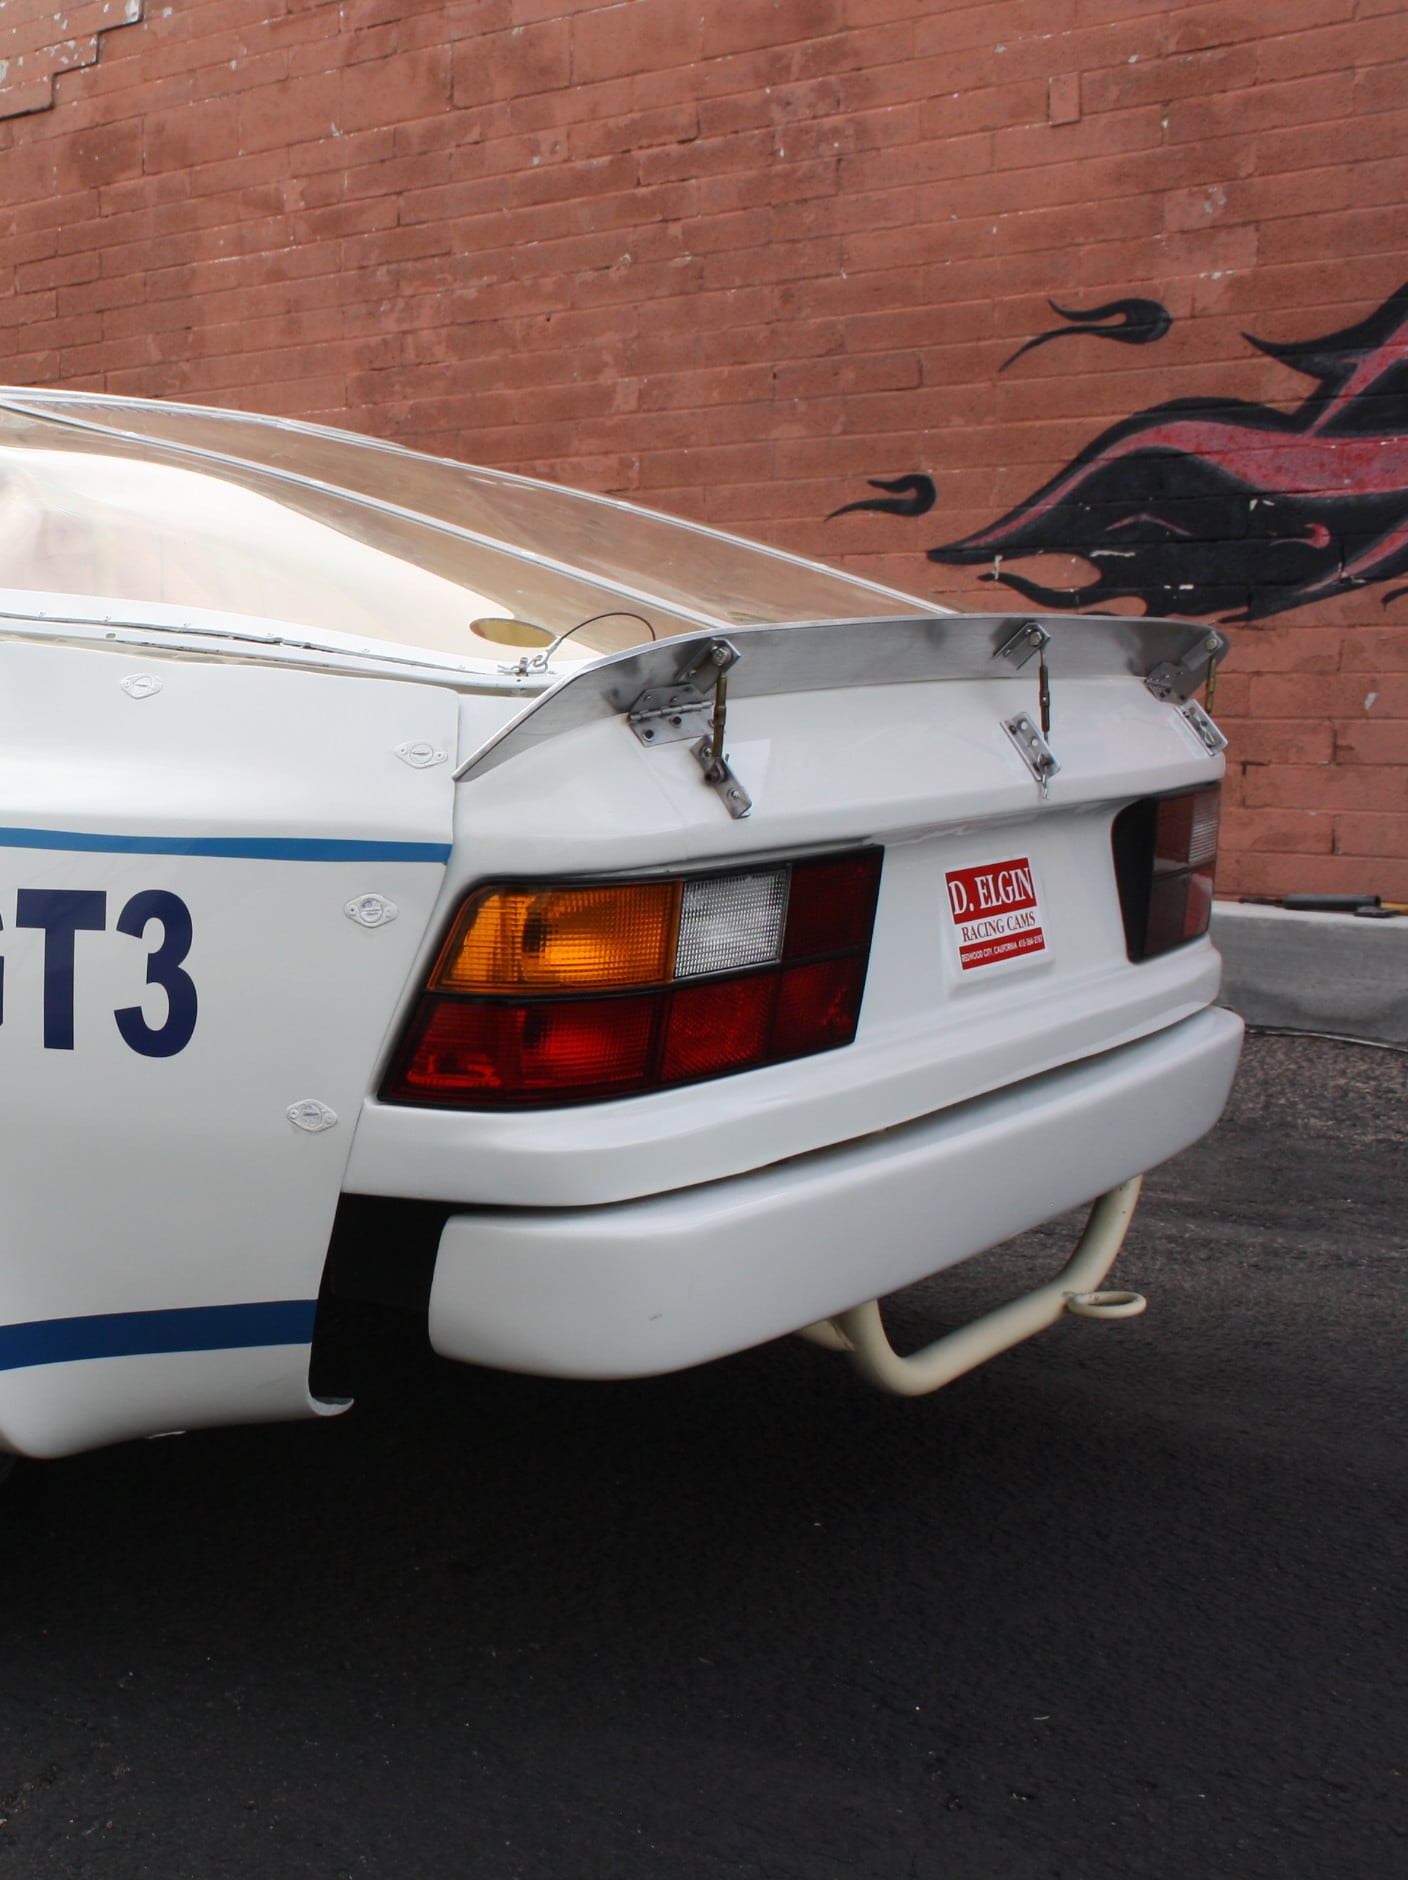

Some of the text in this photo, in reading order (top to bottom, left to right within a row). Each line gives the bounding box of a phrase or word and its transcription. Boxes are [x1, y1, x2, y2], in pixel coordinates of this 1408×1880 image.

[948, 867, 1034, 915] D. ELGIN
[961, 911, 1037, 942] RACING CAMS
[961, 949, 984, 963] REDWOOD
[994, 942, 1018, 955] CALIFORNIA
